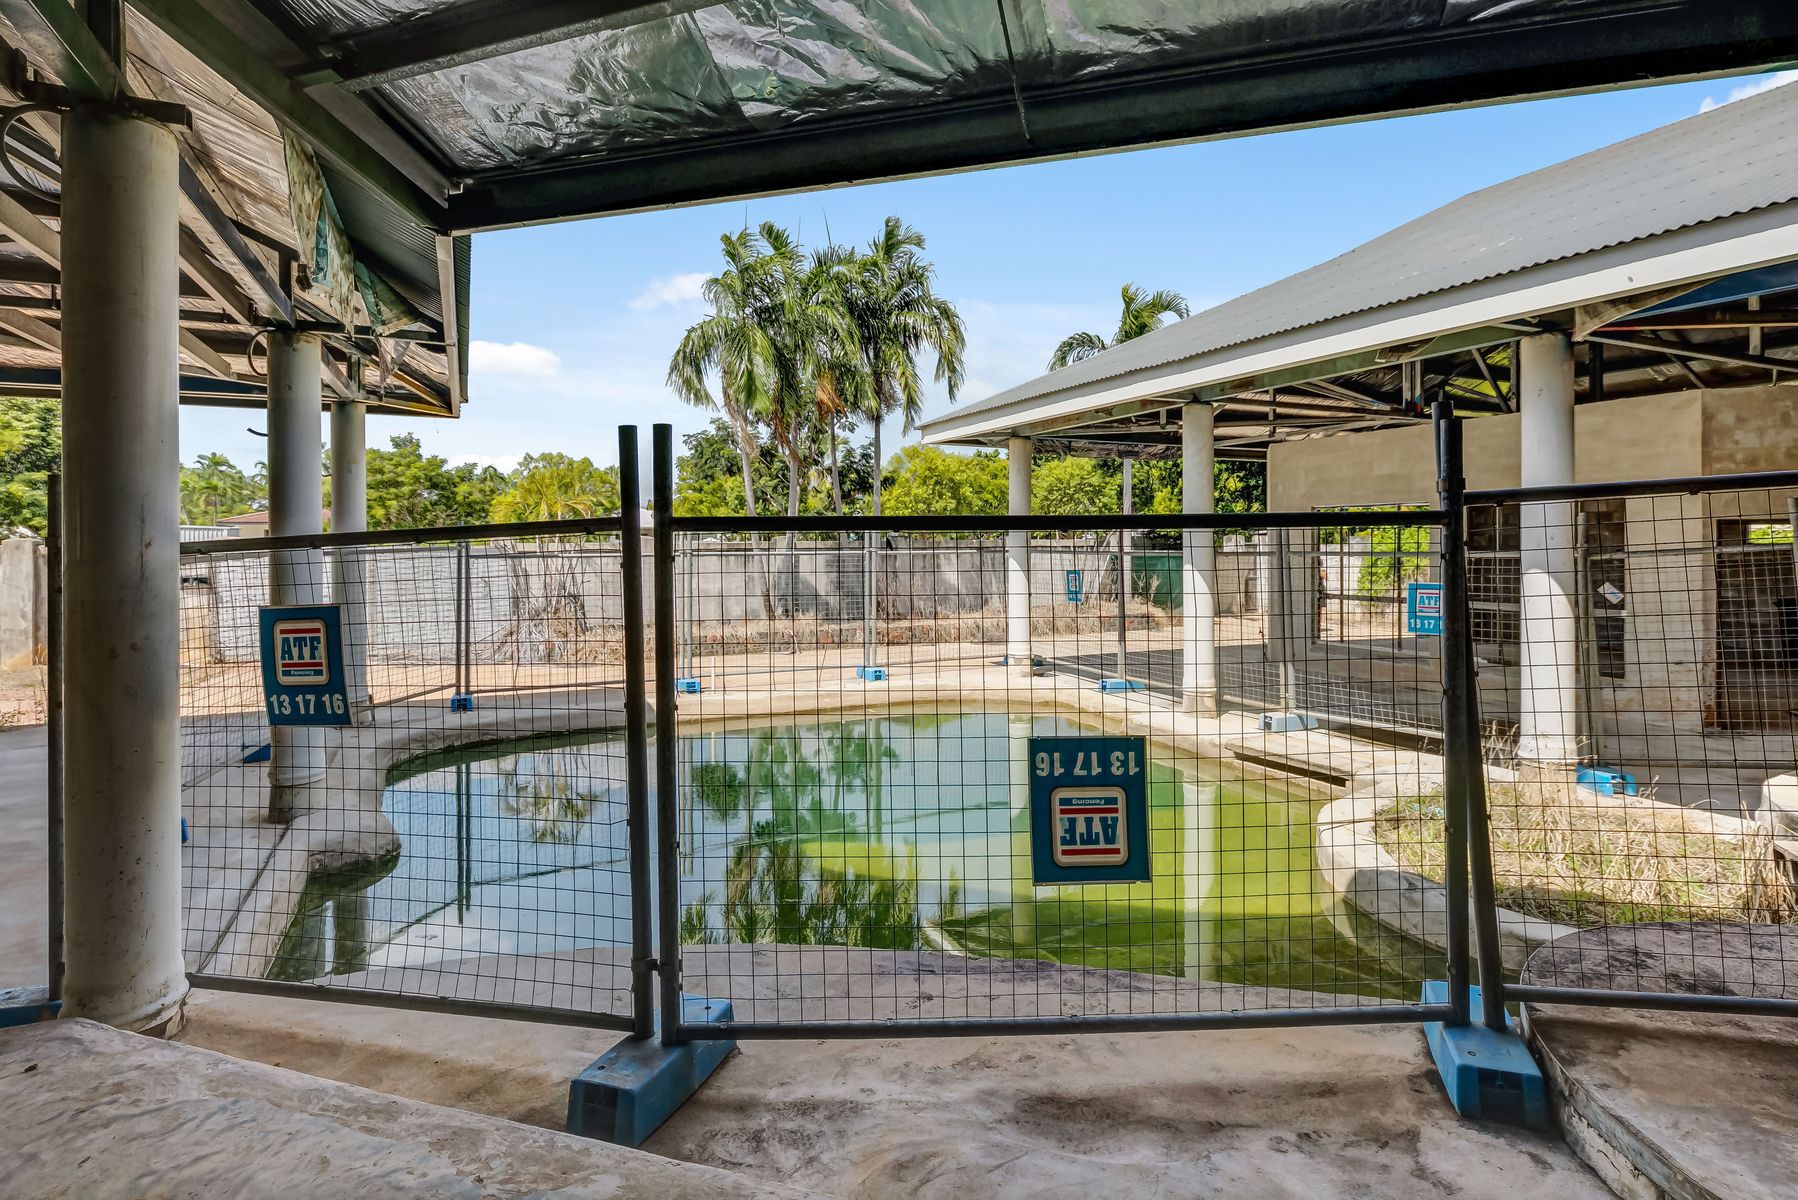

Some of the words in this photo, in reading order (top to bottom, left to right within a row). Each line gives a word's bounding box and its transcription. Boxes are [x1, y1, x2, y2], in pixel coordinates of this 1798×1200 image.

[1419, 595, 1439, 606] ATF
[1410, 619, 1421, 628] 13
[1424, 620, 1435, 629] 17
[280, 636, 322, 661] ATF
[270, 694, 292, 715] 13
[295, 694, 316, 714] 17
[321, 693, 345, 714] 16
[1035, 752, 1065, 777] 16
[1073, 751, 1102, 776] 17
[1110, 751, 1140, 776] 13
[1059, 816, 1119, 846] ATF
